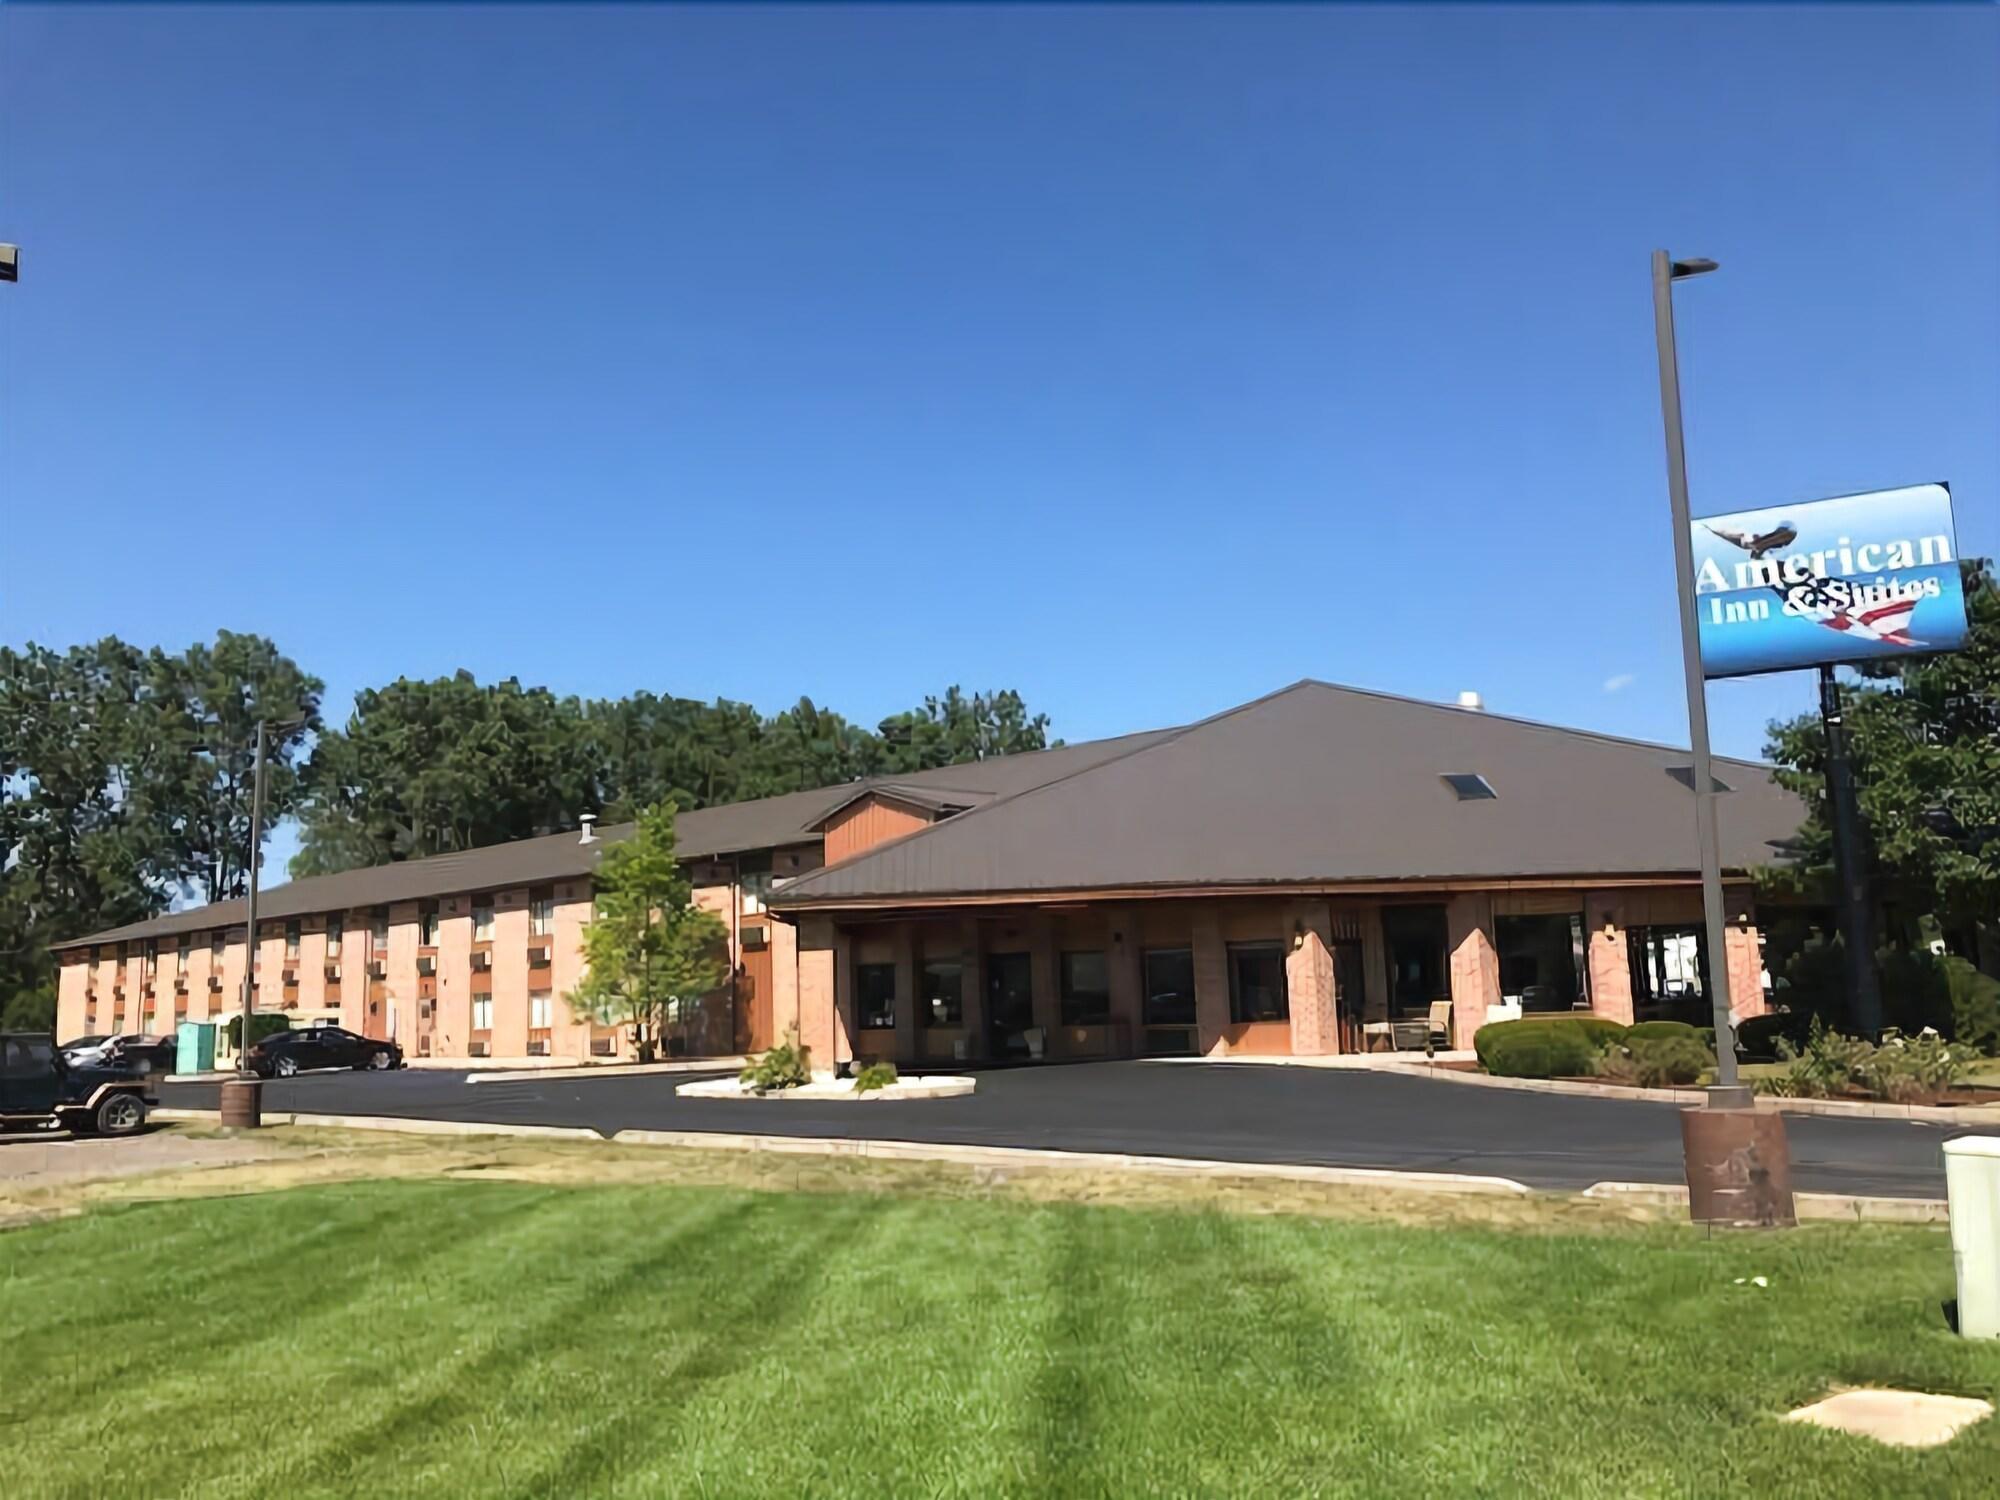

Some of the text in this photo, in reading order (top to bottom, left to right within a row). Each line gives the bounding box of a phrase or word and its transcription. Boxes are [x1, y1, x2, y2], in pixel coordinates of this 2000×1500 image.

[1695, 533, 1952, 593] American
[1706, 597, 1770, 624] Inn
[1821, 576, 1941, 611] Suites
